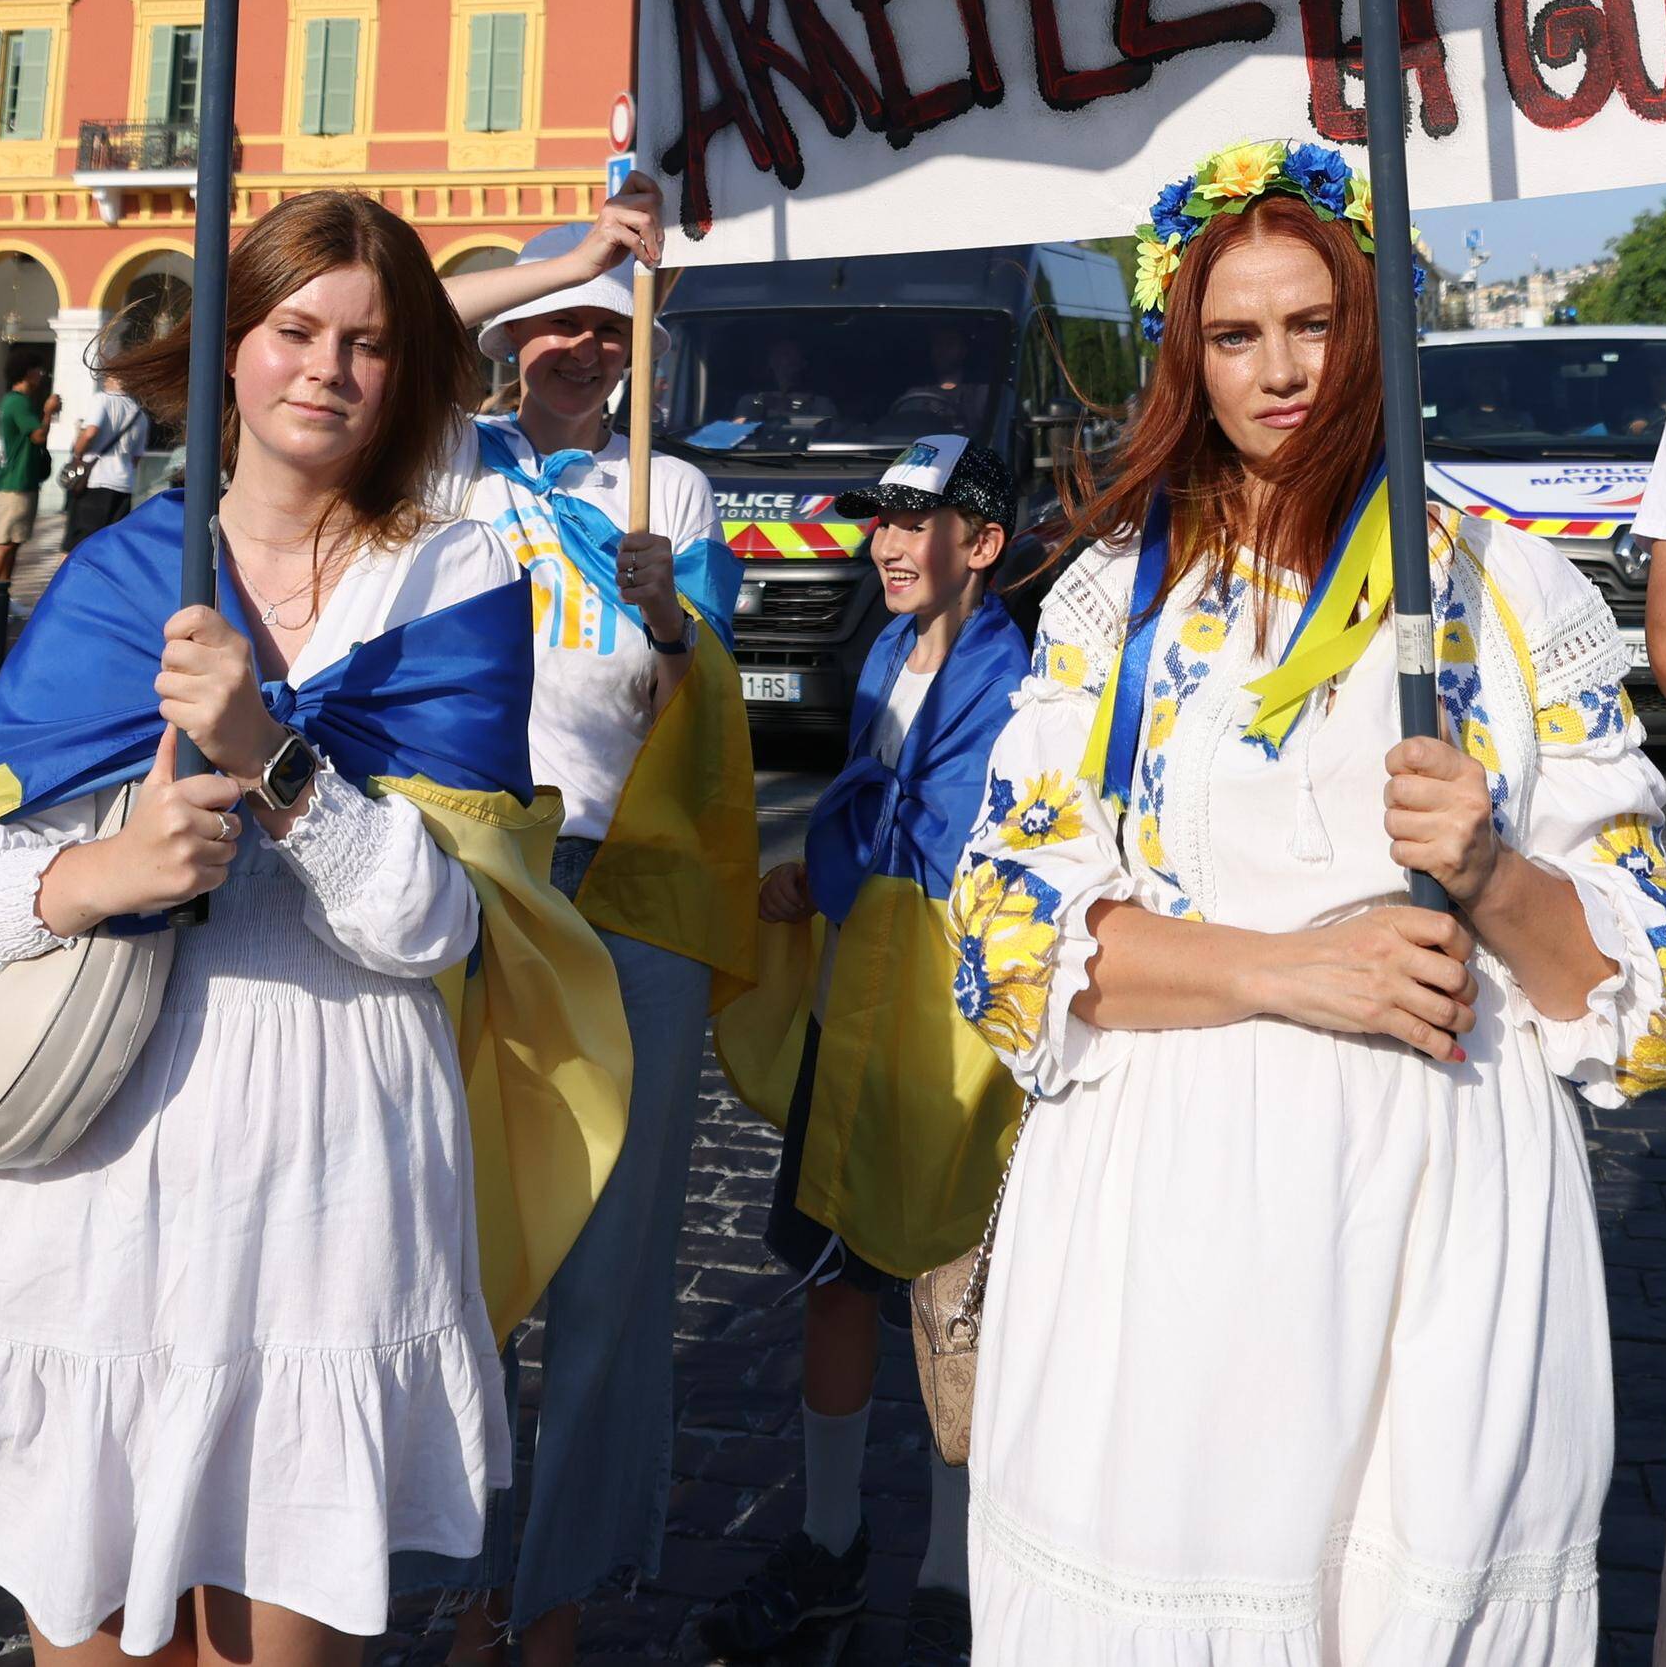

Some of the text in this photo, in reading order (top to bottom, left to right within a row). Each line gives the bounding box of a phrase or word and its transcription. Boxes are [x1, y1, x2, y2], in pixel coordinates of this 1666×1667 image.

[1563, 467, 1652, 476] POLIC
[1530, 475, 1648, 486] NATION
[713, 492, 797, 509] OLICE
[719, 509, 792, 521] IONALE
[746, 677, 786, 699] 1-RS
